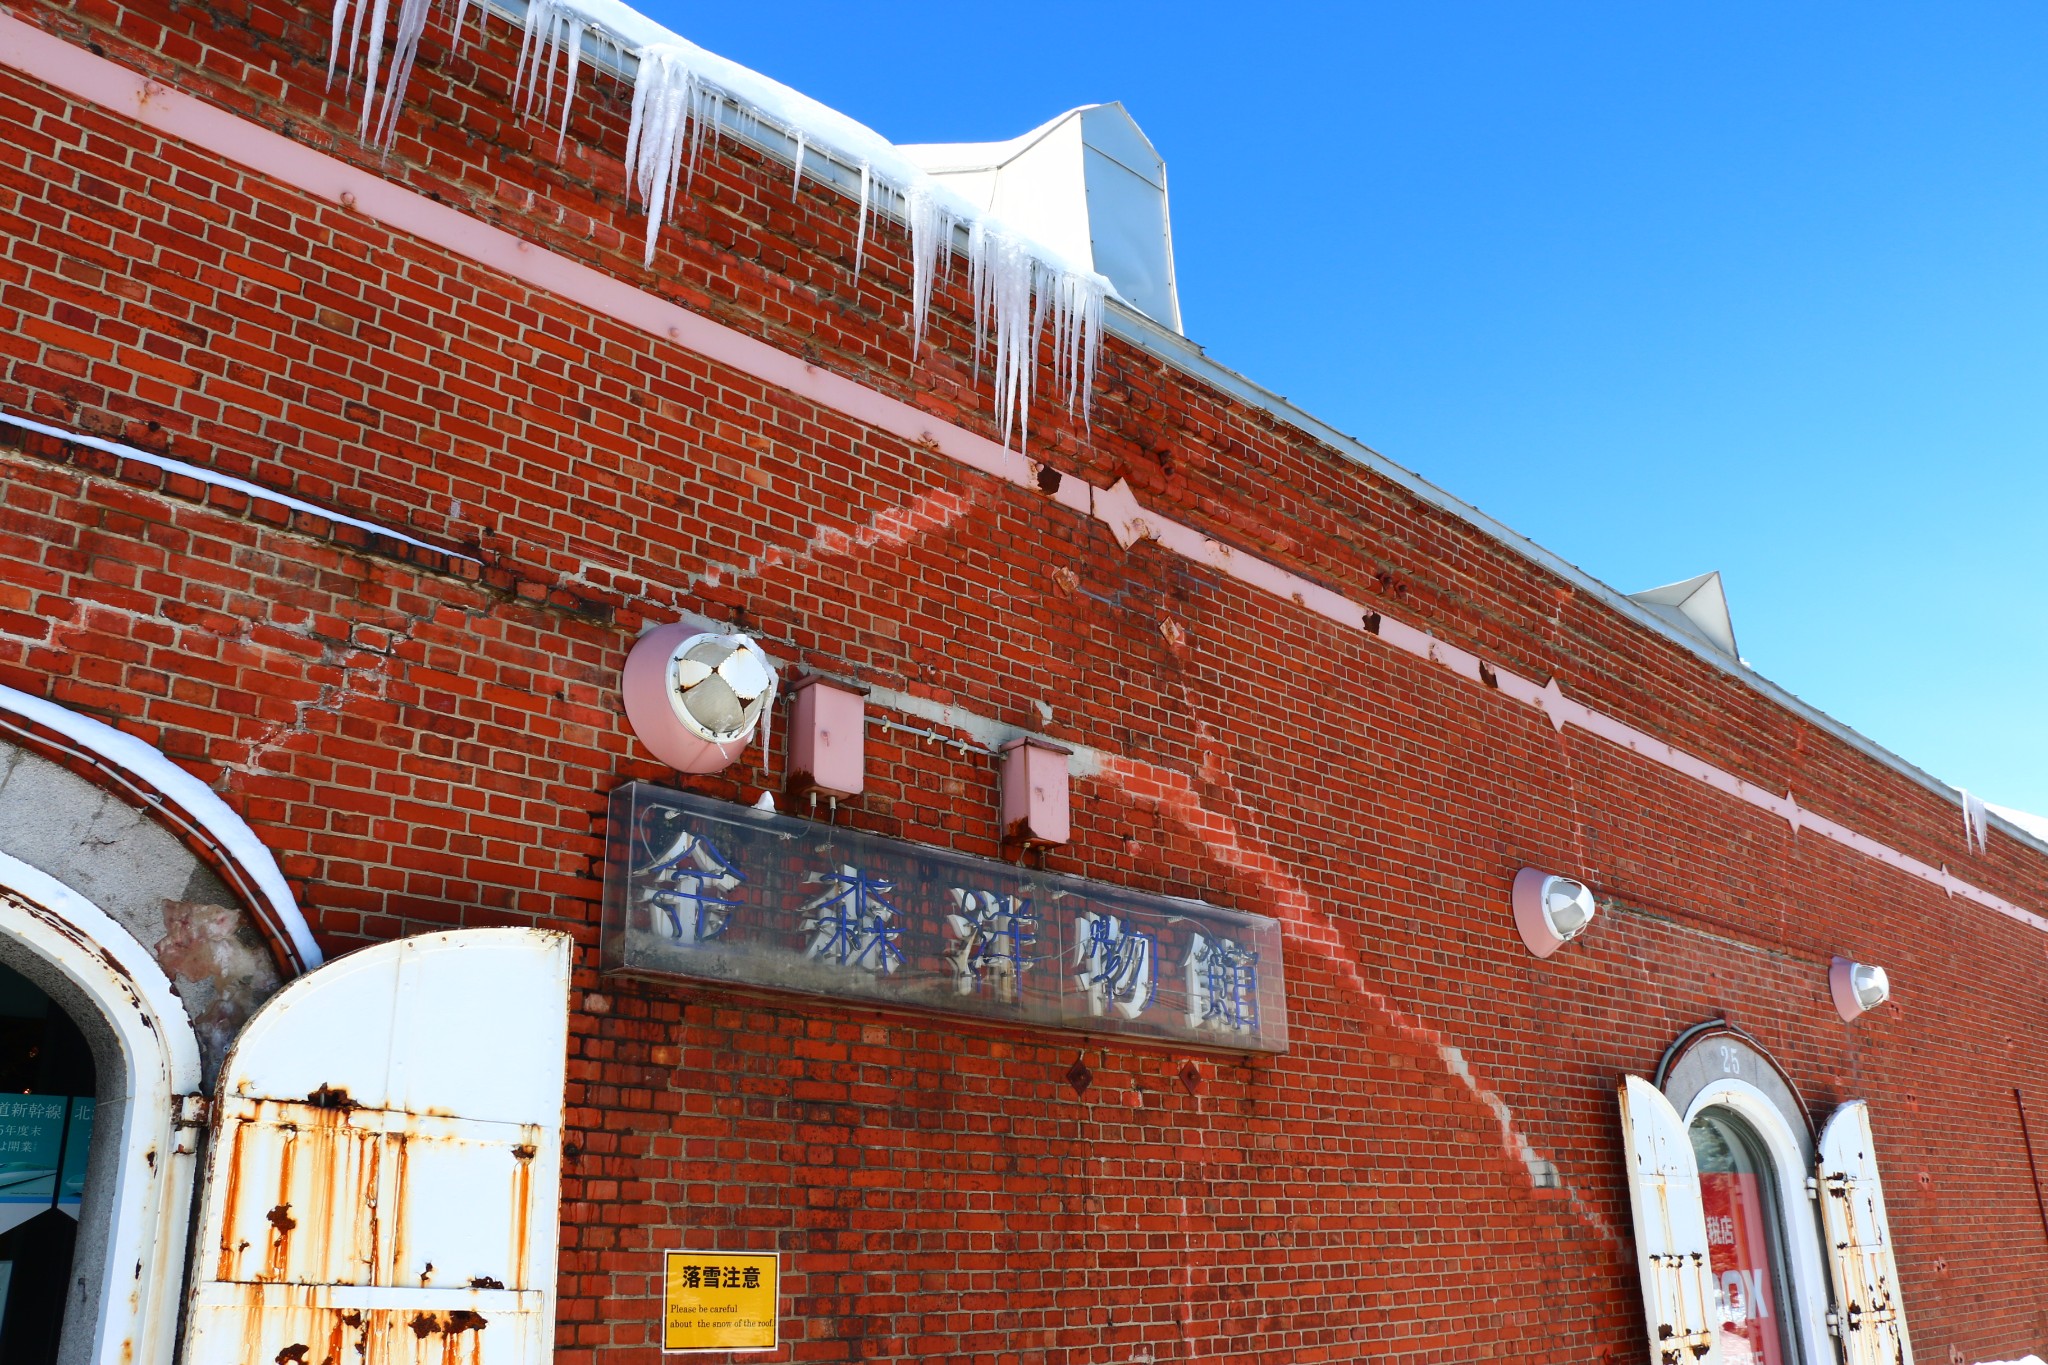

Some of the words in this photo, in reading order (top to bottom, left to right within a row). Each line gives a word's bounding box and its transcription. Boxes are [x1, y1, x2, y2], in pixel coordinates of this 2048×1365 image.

[1720, 1045, 1740, 1074] 25
[682, 1265, 761, 1289] 落雪注意
[670, 1304, 697, 1314] Please
[698, 1304, 708, 1313] be
[709, 1304, 738, 1313] careful
[670, 1319, 692, 1328] about
[697, 1319, 711, 1328] the
[734, 1318, 742, 1328] of
[743, 1319, 756, 1328] the
